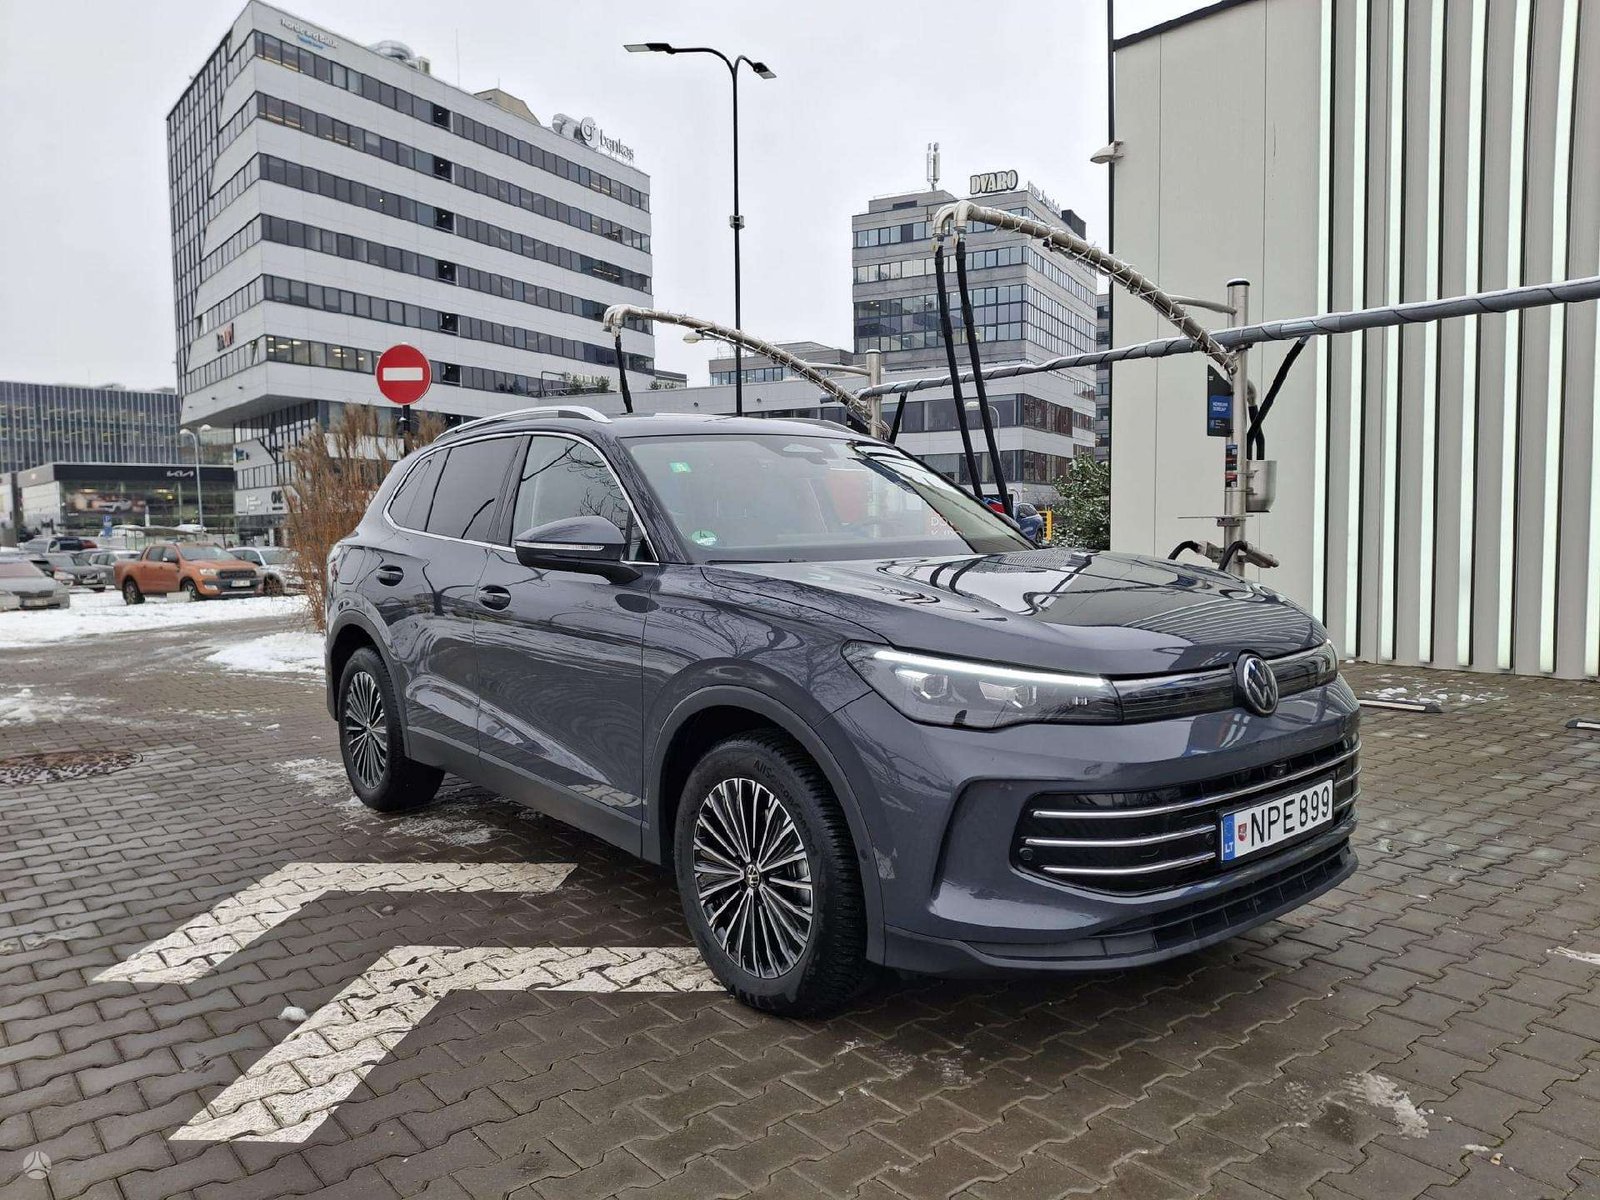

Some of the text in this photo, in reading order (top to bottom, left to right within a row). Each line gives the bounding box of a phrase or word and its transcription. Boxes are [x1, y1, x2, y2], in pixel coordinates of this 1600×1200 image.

[600, 128, 634, 161] bankas
[970, 169, 1018, 195] DVARO
[1224, 841, 1234, 853] LT
